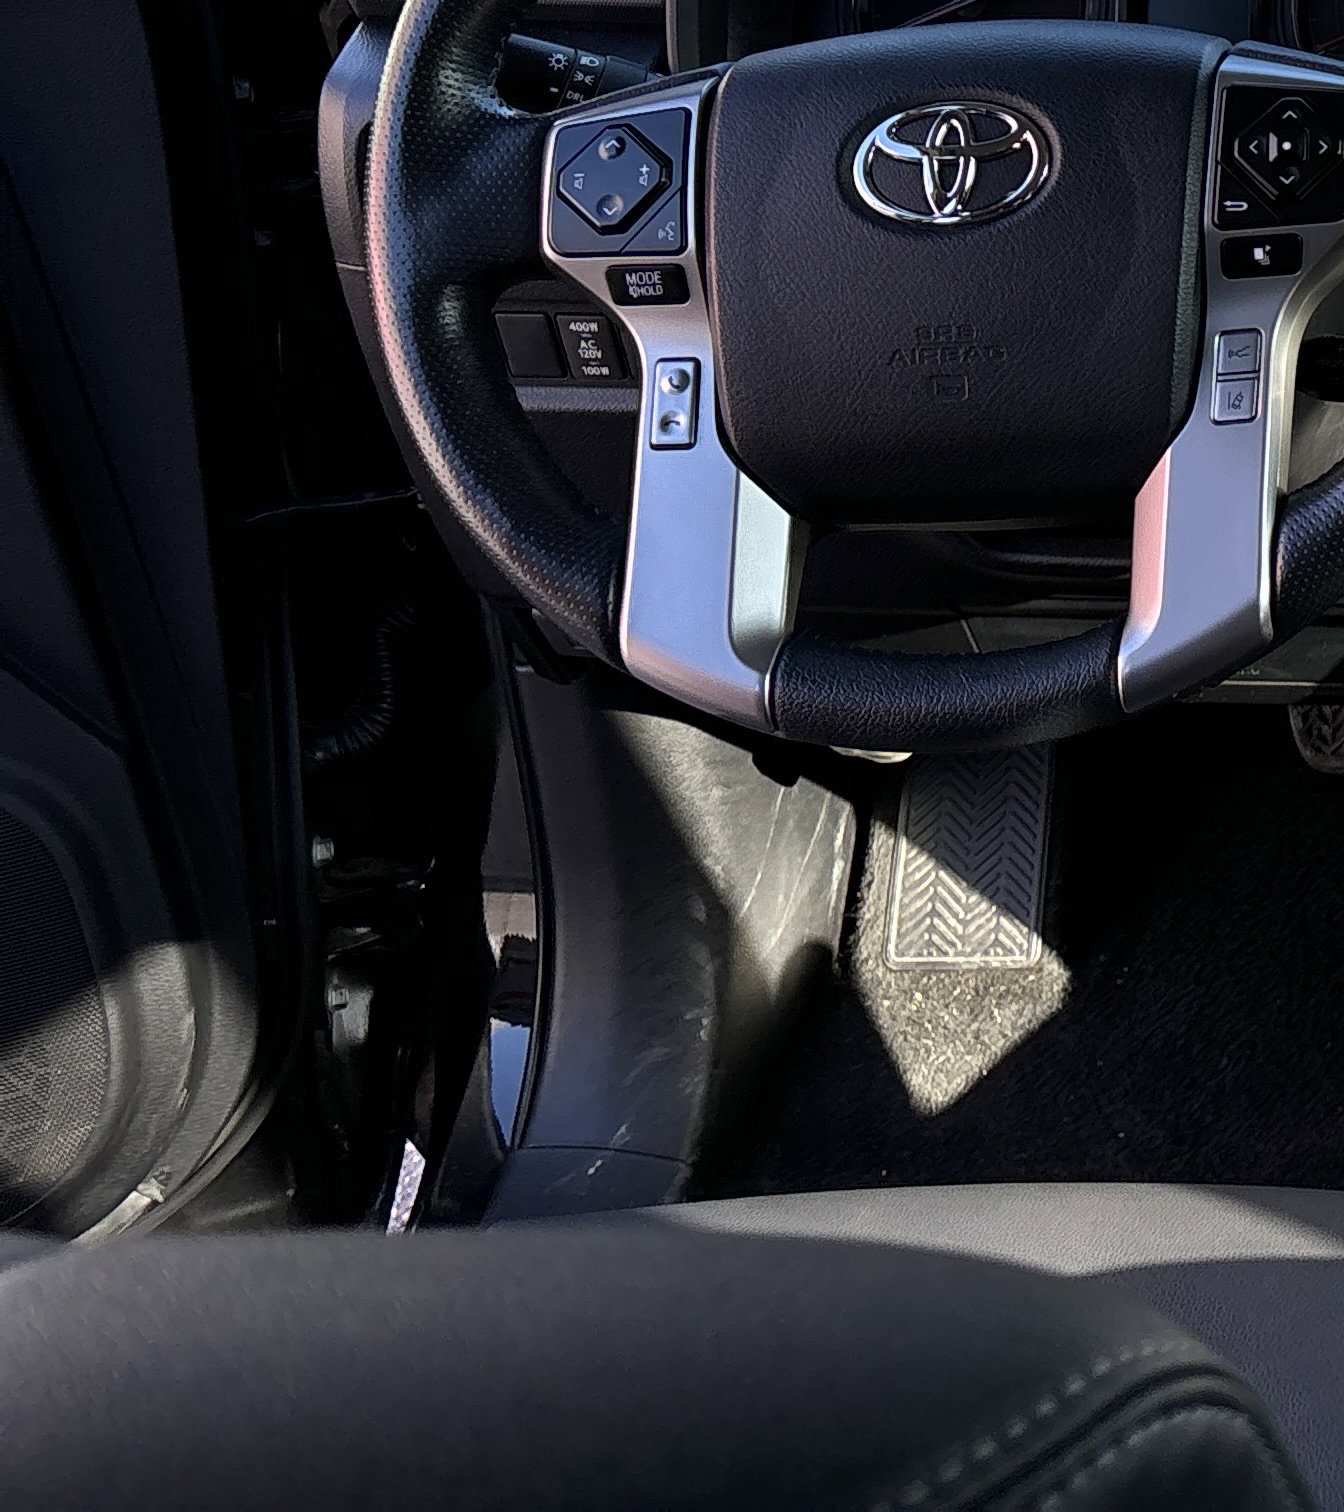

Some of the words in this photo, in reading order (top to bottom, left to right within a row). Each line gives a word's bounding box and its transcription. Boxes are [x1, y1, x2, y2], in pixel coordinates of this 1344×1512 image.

[566, 90, 586, 102] DRL
[626, 270, 663, 286] MODE
[637, 285, 663, 296] HOLD
[569, 321, 599, 333] 400W
[580, 340, 598, 350] AC
[577, 348, 602, 359] 120V
[582, 366, 610, 376] 100W
